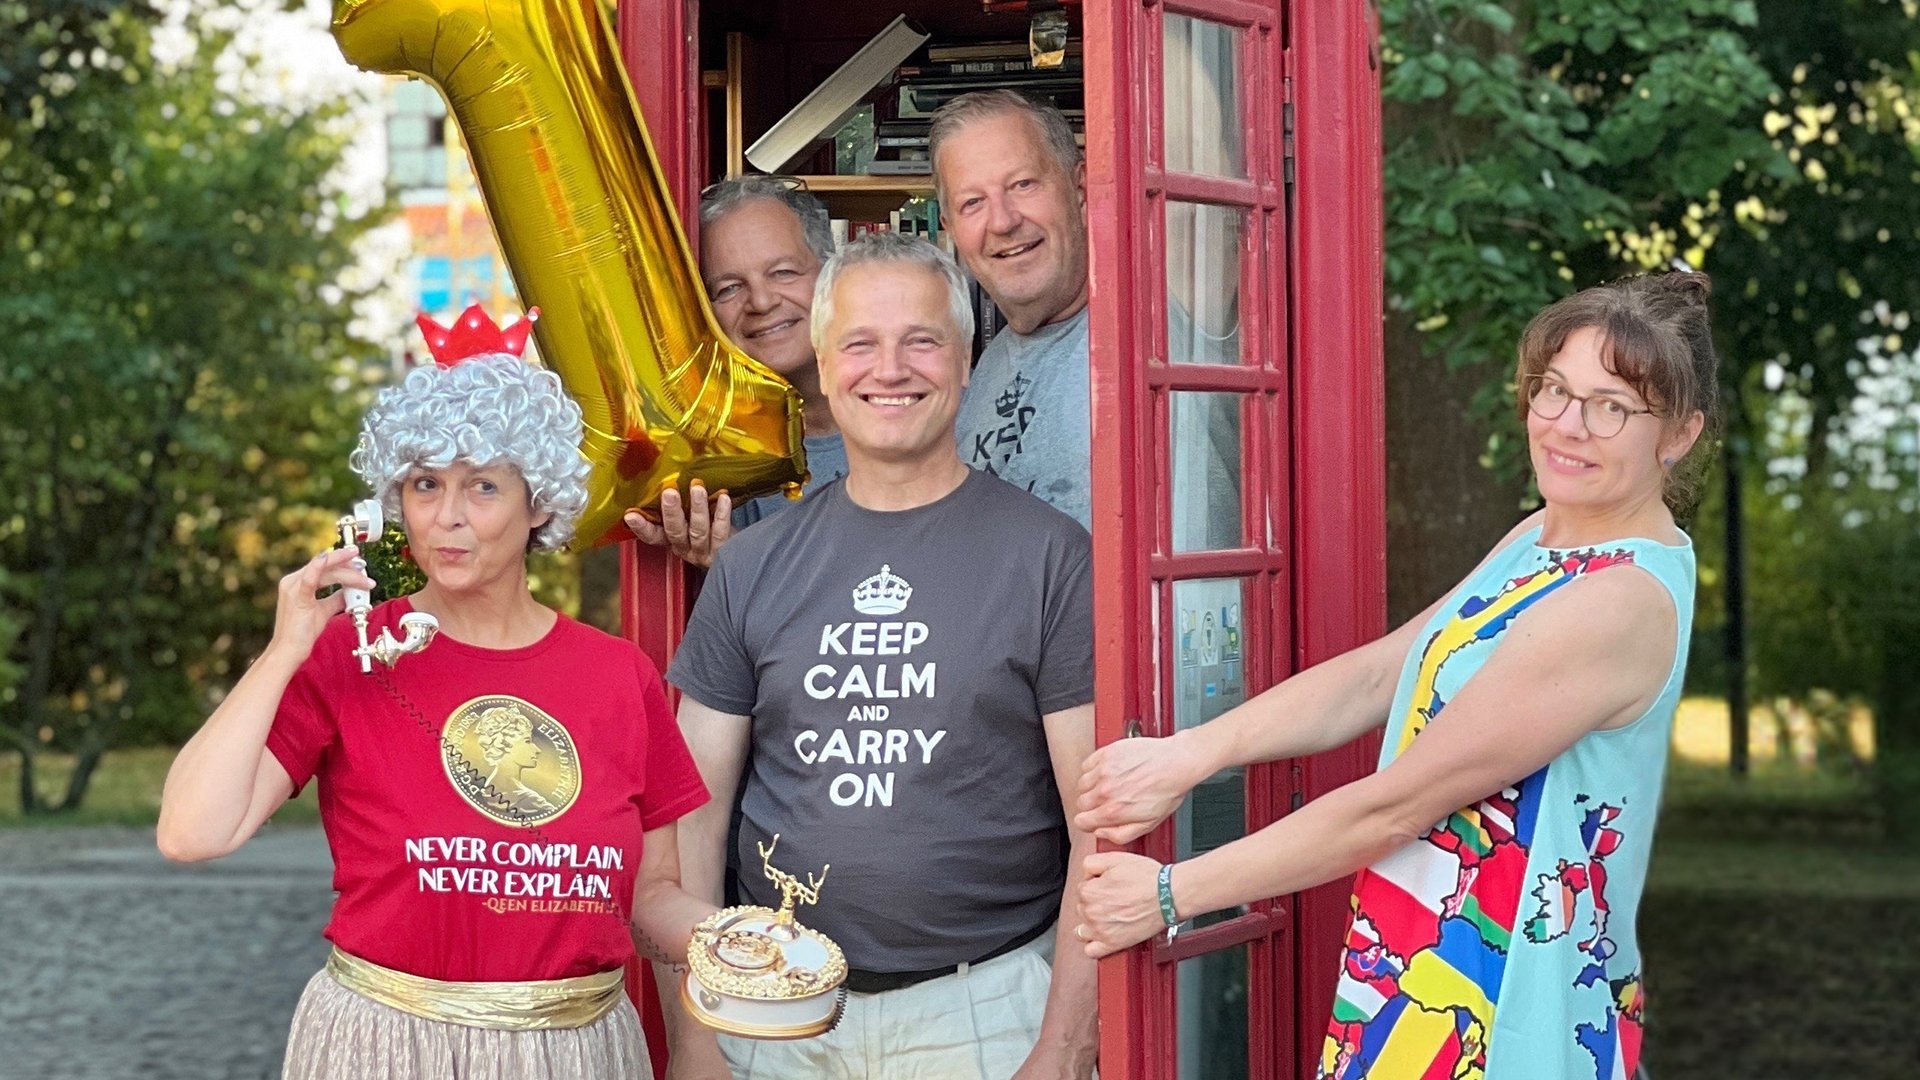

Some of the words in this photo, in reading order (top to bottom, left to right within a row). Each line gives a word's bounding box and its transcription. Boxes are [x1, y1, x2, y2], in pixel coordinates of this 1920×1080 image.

[819, 621, 929, 655] KEEP
[804, 663, 936, 700] CALM
[847, 705, 890, 722] AND
[794, 728, 947, 765] CARRY
[829, 772, 895, 807] ON
[405, 836, 487, 863] NEVER
[491, 841, 624, 870] COMPLAIN.
[418, 867, 499, 894] NEVER
[504, 871, 612, 898] EXPLAIN.
[530, 899, 604, 914] ELIZABETH
